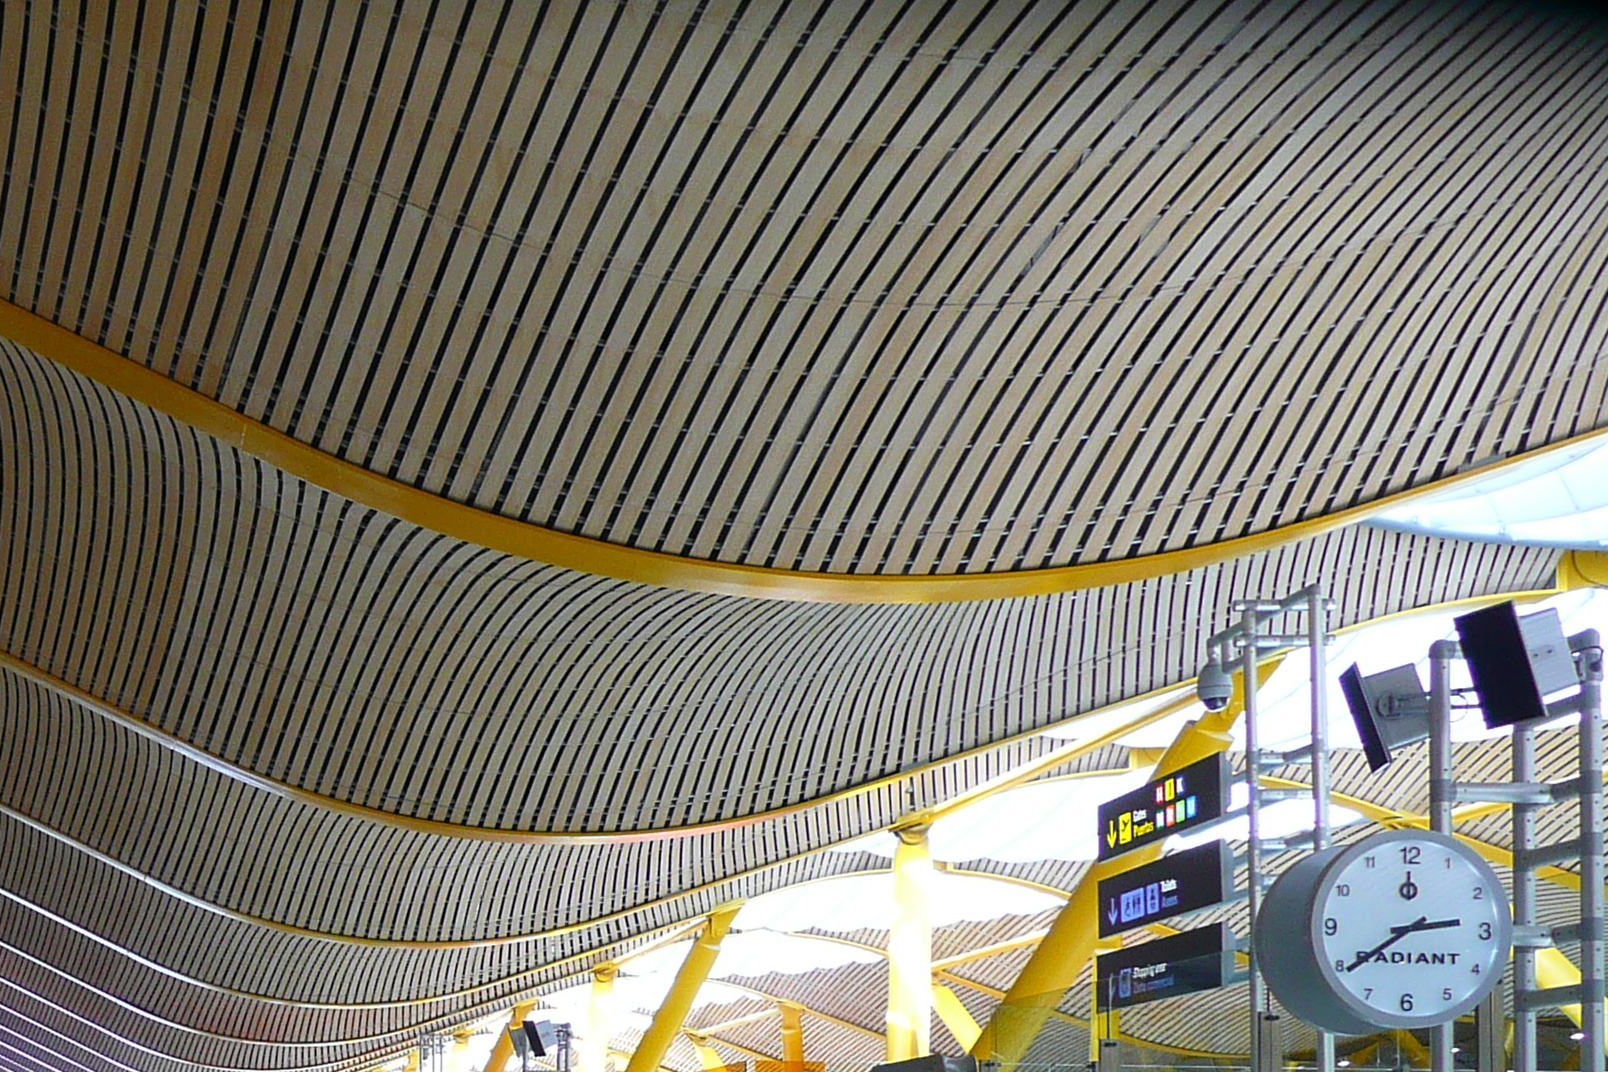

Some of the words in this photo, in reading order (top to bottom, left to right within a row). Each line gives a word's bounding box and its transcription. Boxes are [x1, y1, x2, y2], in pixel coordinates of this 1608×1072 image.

[1399, 846, 1421, 865] 12
[1365, 856, 1376, 868] 11
[1445, 857, 1451, 869] 1
[1336, 885, 1350, 897] 10
[1473, 887, 1483, 900] 2
[1324, 918, 1337, 936] 9
[1478, 922, 1492, 940] 3
[1335, 960, 1345, 972] 8
[1471, 964, 1480, 975] 4
[1363, 988, 1373, 1000] 7
[1443, 989, 1452, 1001] 5
[1400, 993, 1414, 1012] 6
